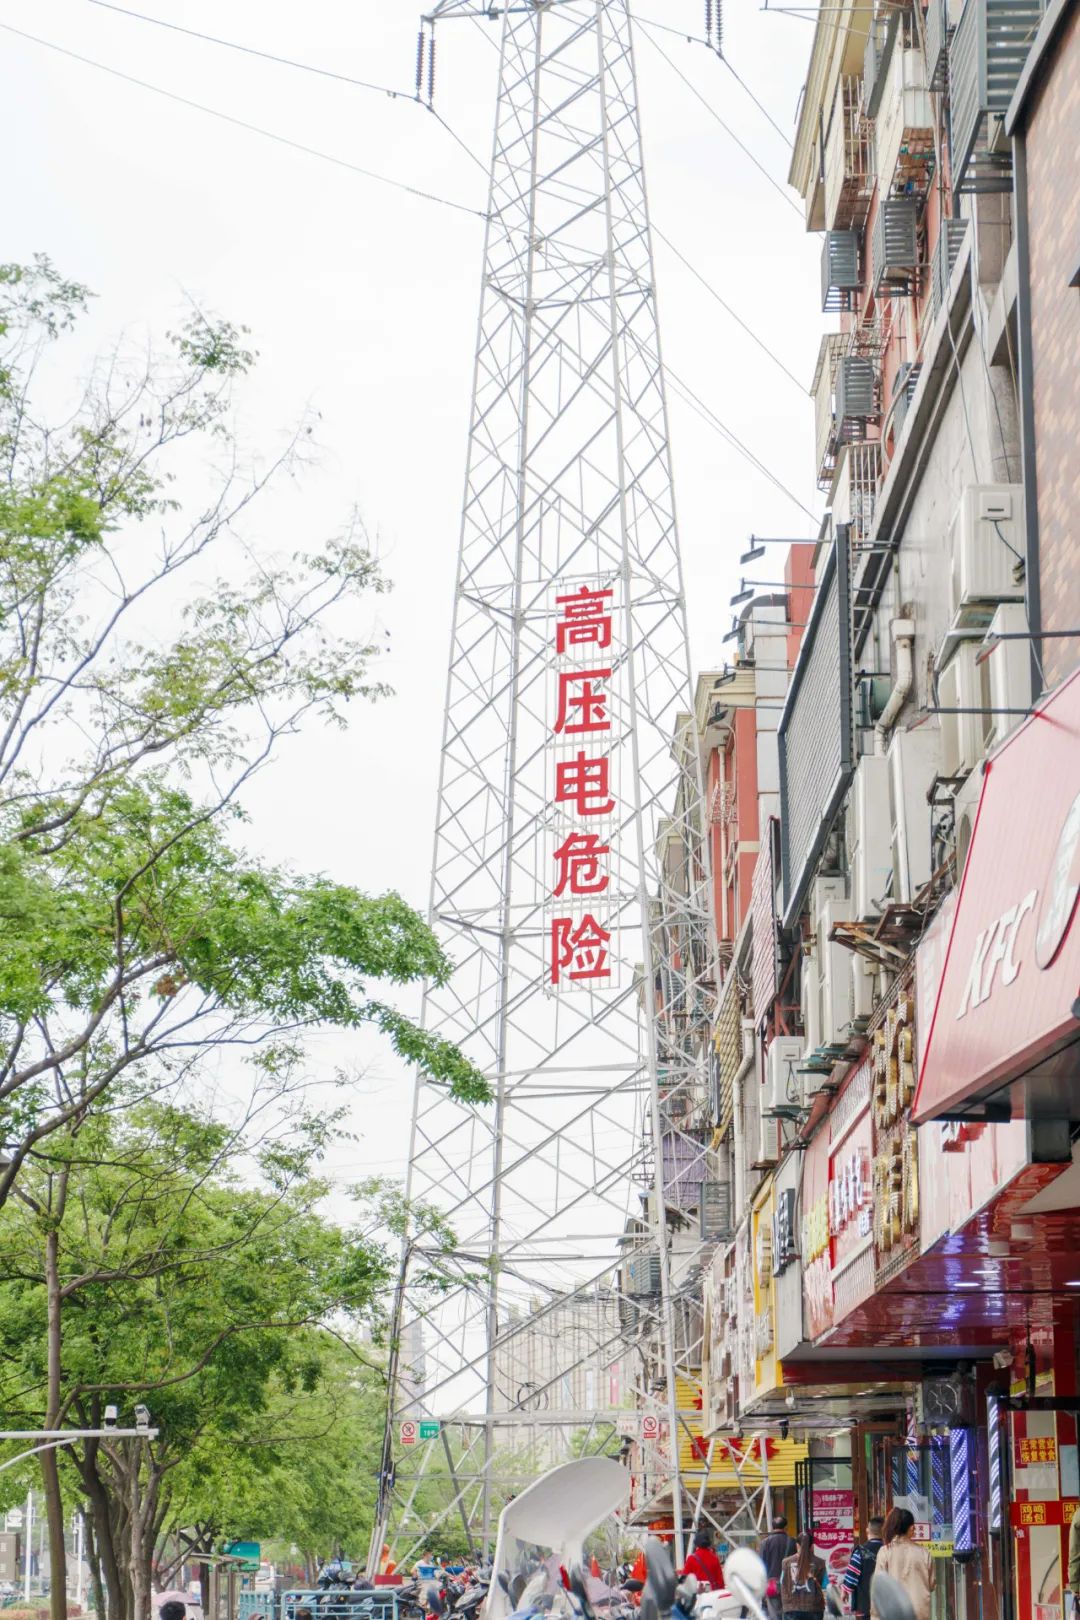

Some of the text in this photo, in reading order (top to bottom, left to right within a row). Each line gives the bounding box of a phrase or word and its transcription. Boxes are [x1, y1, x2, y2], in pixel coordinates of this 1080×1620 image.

[551, 585, 615, 986] 高压电危险
[956, 888, 1038, 1021] KFC
